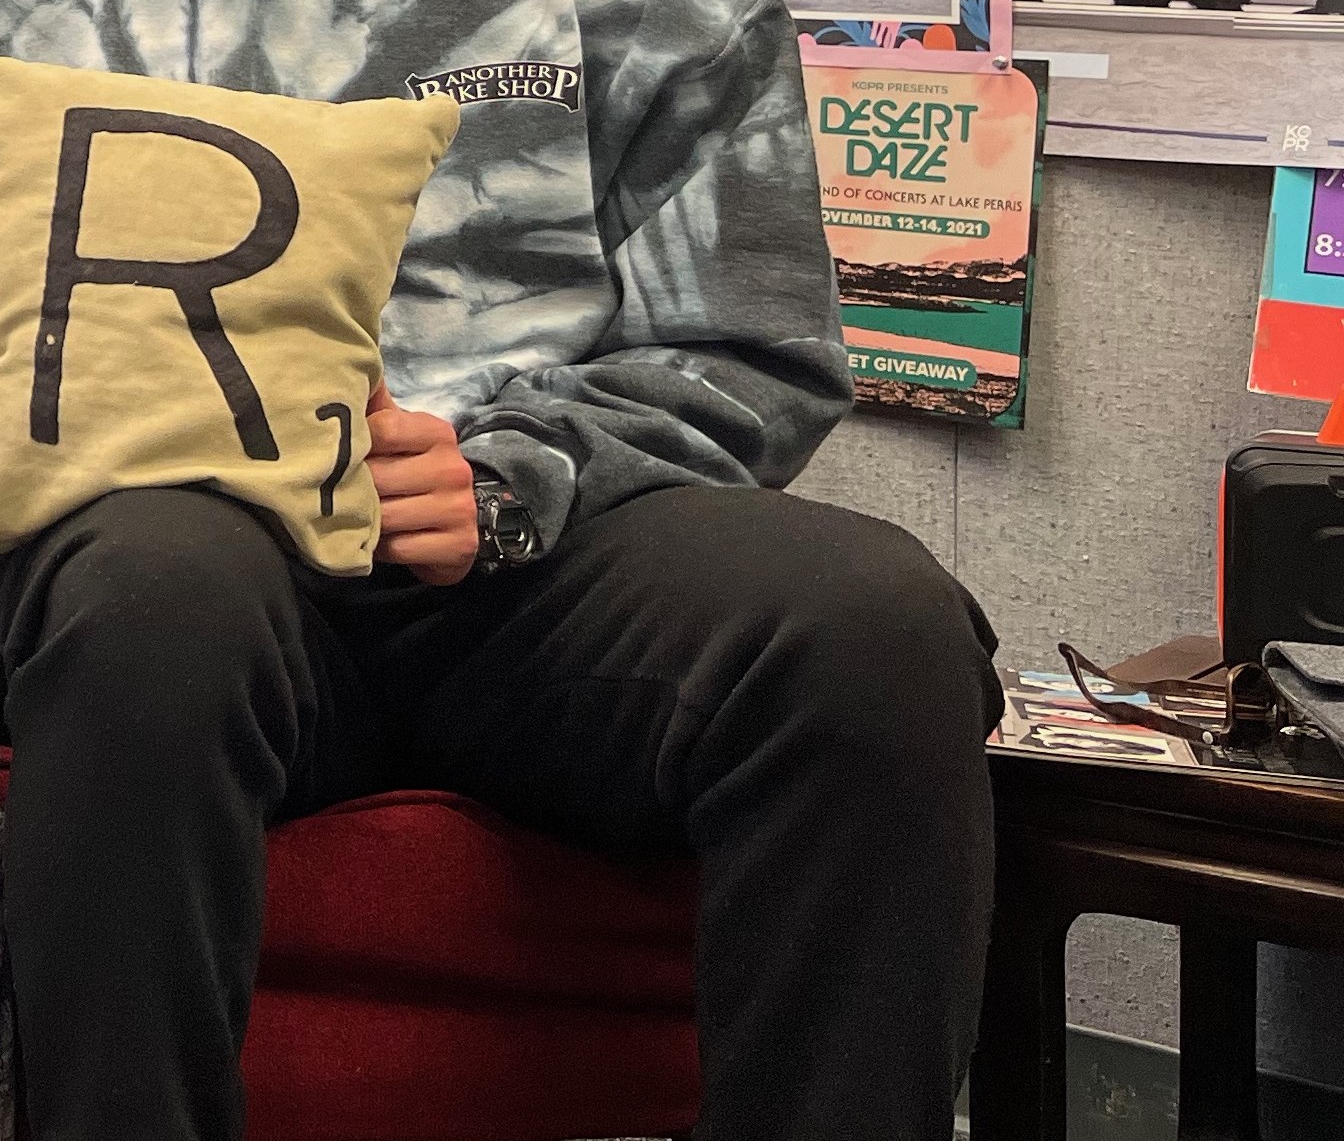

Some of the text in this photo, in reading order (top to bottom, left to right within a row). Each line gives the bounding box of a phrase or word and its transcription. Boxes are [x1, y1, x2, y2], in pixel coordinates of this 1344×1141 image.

[445, 65, 553, 87] ANOTHER
[497, 68, 578, 100] SHOP
[851, 81, 948, 95] KCPR PRESENTS
[819, 96, 979, 143] DESERT
[846, 138, 948, 183] DAZE
[843, 187, 861, 199] OF
[865, 189, 926, 205] CONCERTS
[930, 194, 945, 207] AT
[949, 195, 980, 209] LAKE
[984, 198, 1022, 212] PERRIS
[822, 210, 983, 236] OVEMBER 12-14, 2021
[29, 107, 300, 462] R
[873, 356, 969, 382] GIVEAWAY
